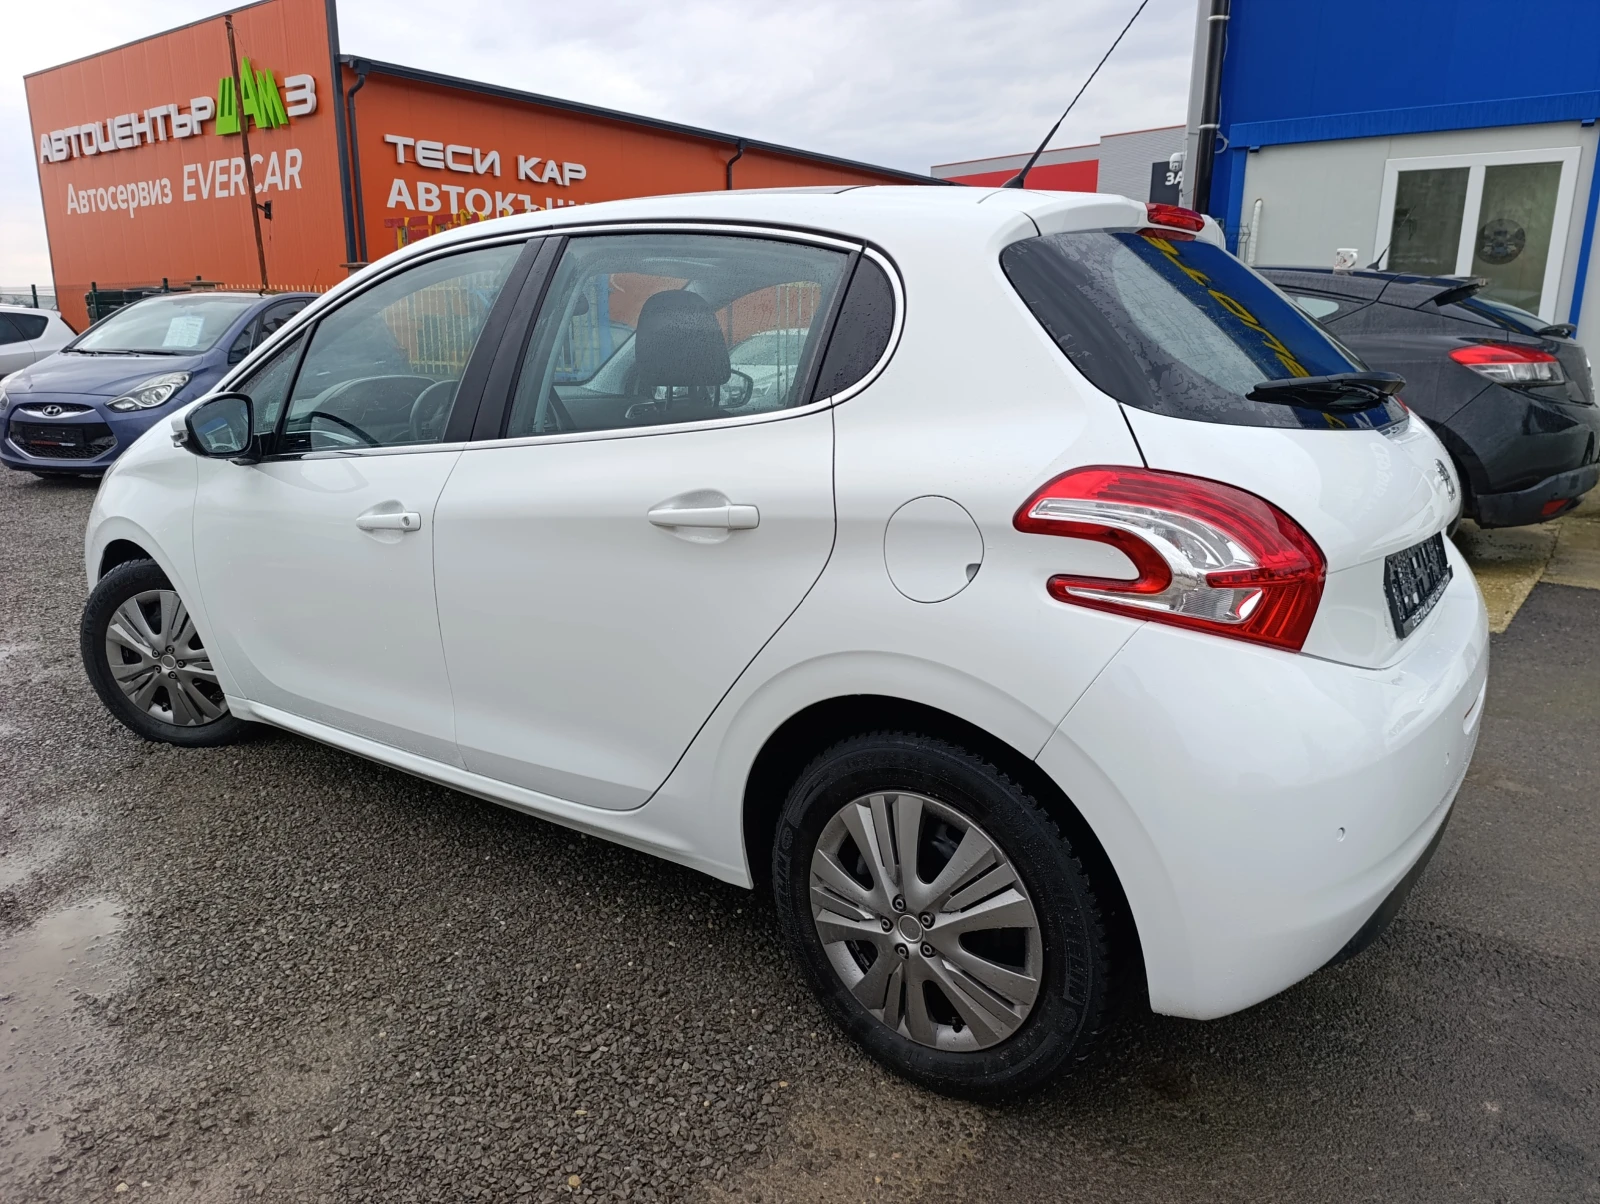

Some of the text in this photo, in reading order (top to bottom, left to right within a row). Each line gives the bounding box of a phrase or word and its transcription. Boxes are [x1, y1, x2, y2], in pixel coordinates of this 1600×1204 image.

[40, 96, 215, 164] АВТОЦЕНТЪР
[384, 134, 587, 186] ТЕСИ КАР
[67, 148, 303, 218] Автосервиз EVERCAR
